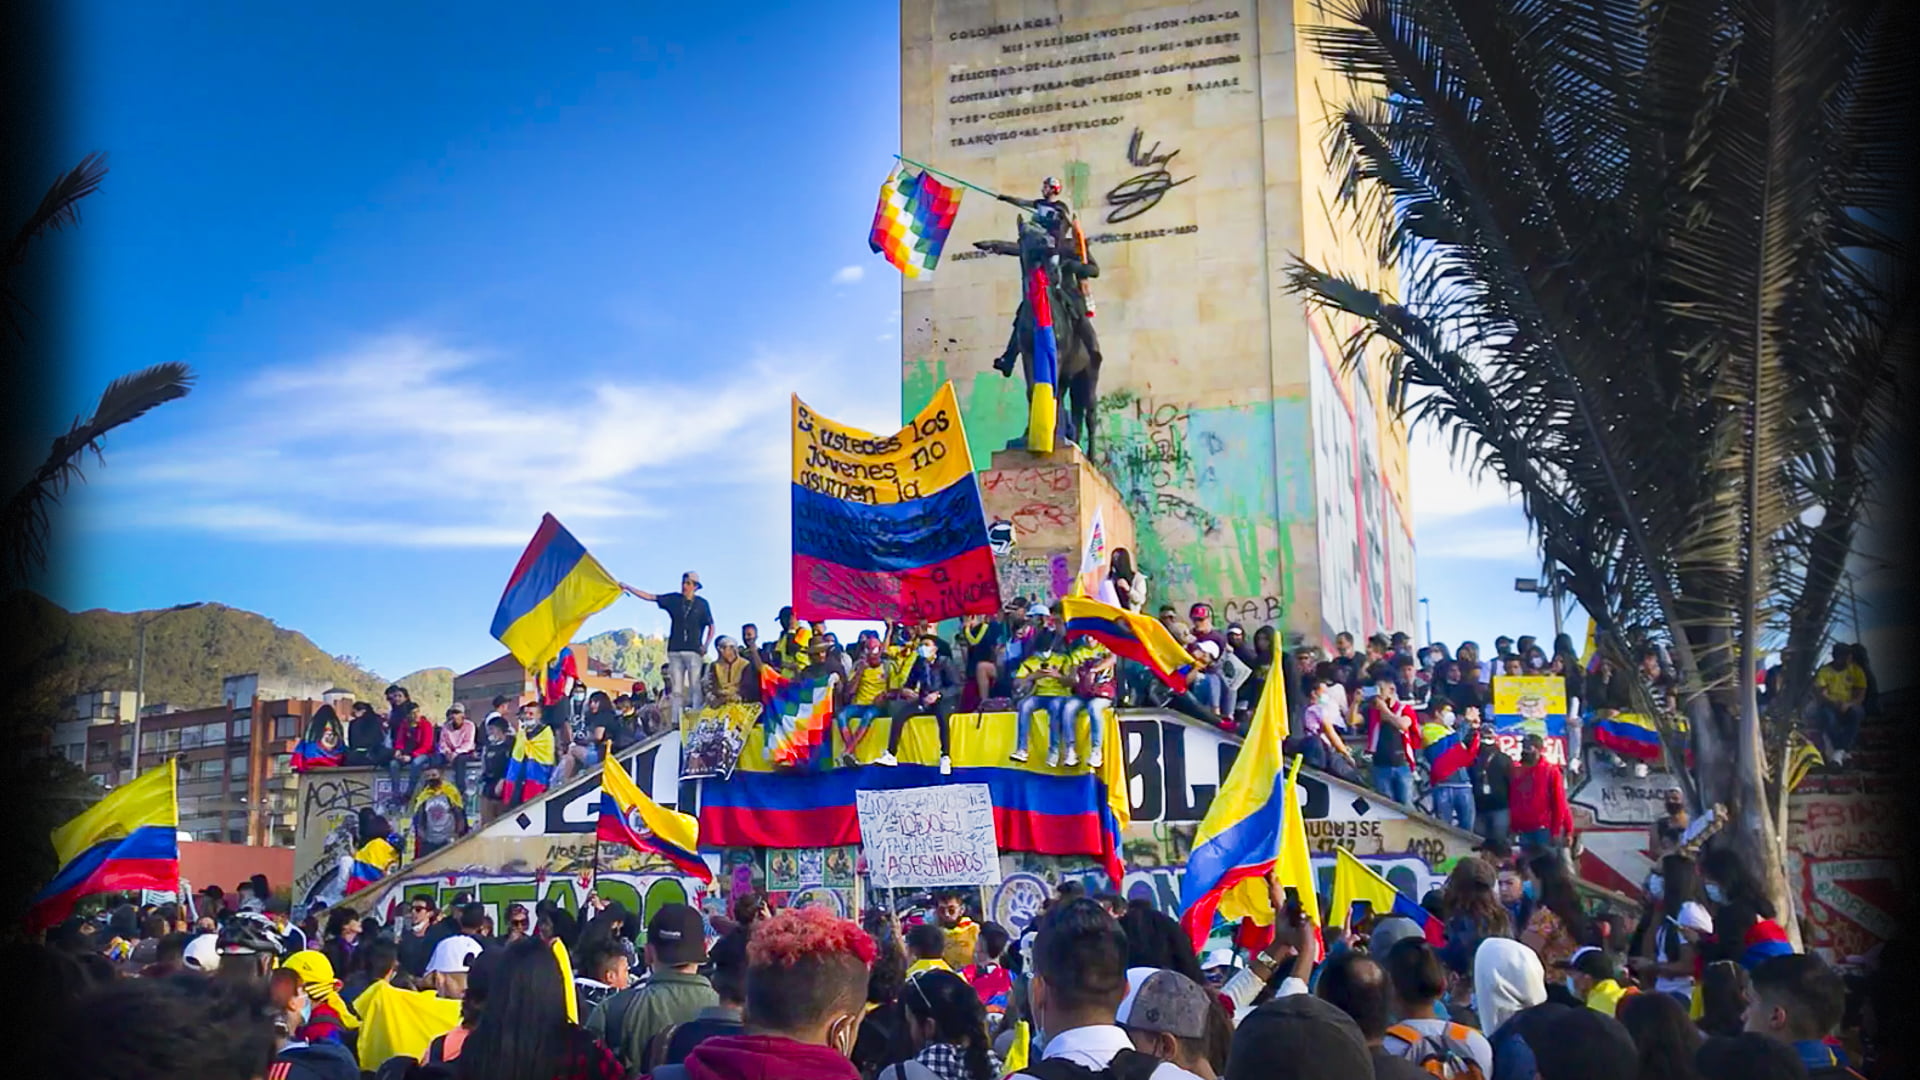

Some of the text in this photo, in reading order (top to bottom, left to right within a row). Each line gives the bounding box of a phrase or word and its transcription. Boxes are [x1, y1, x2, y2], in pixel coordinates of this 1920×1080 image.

[1153, 18, 1180, 31] SON
[1190, 13, 1217, 25] POR
[1225, 10, 1240, 20] LA
[1048, 59, 1065, 69] LA
[1152, 63, 1175, 75] LOS
[1071, 98, 1089, 109] LA
[1154, 86, 1173, 97] YO
[1022, 127, 1040, 138] AL
[820, 427, 903, 456] ustedes
[909, 409, 950, 444] los
[911, 440, 947, 472] no
[800, 469, 923, 505] asumen la
